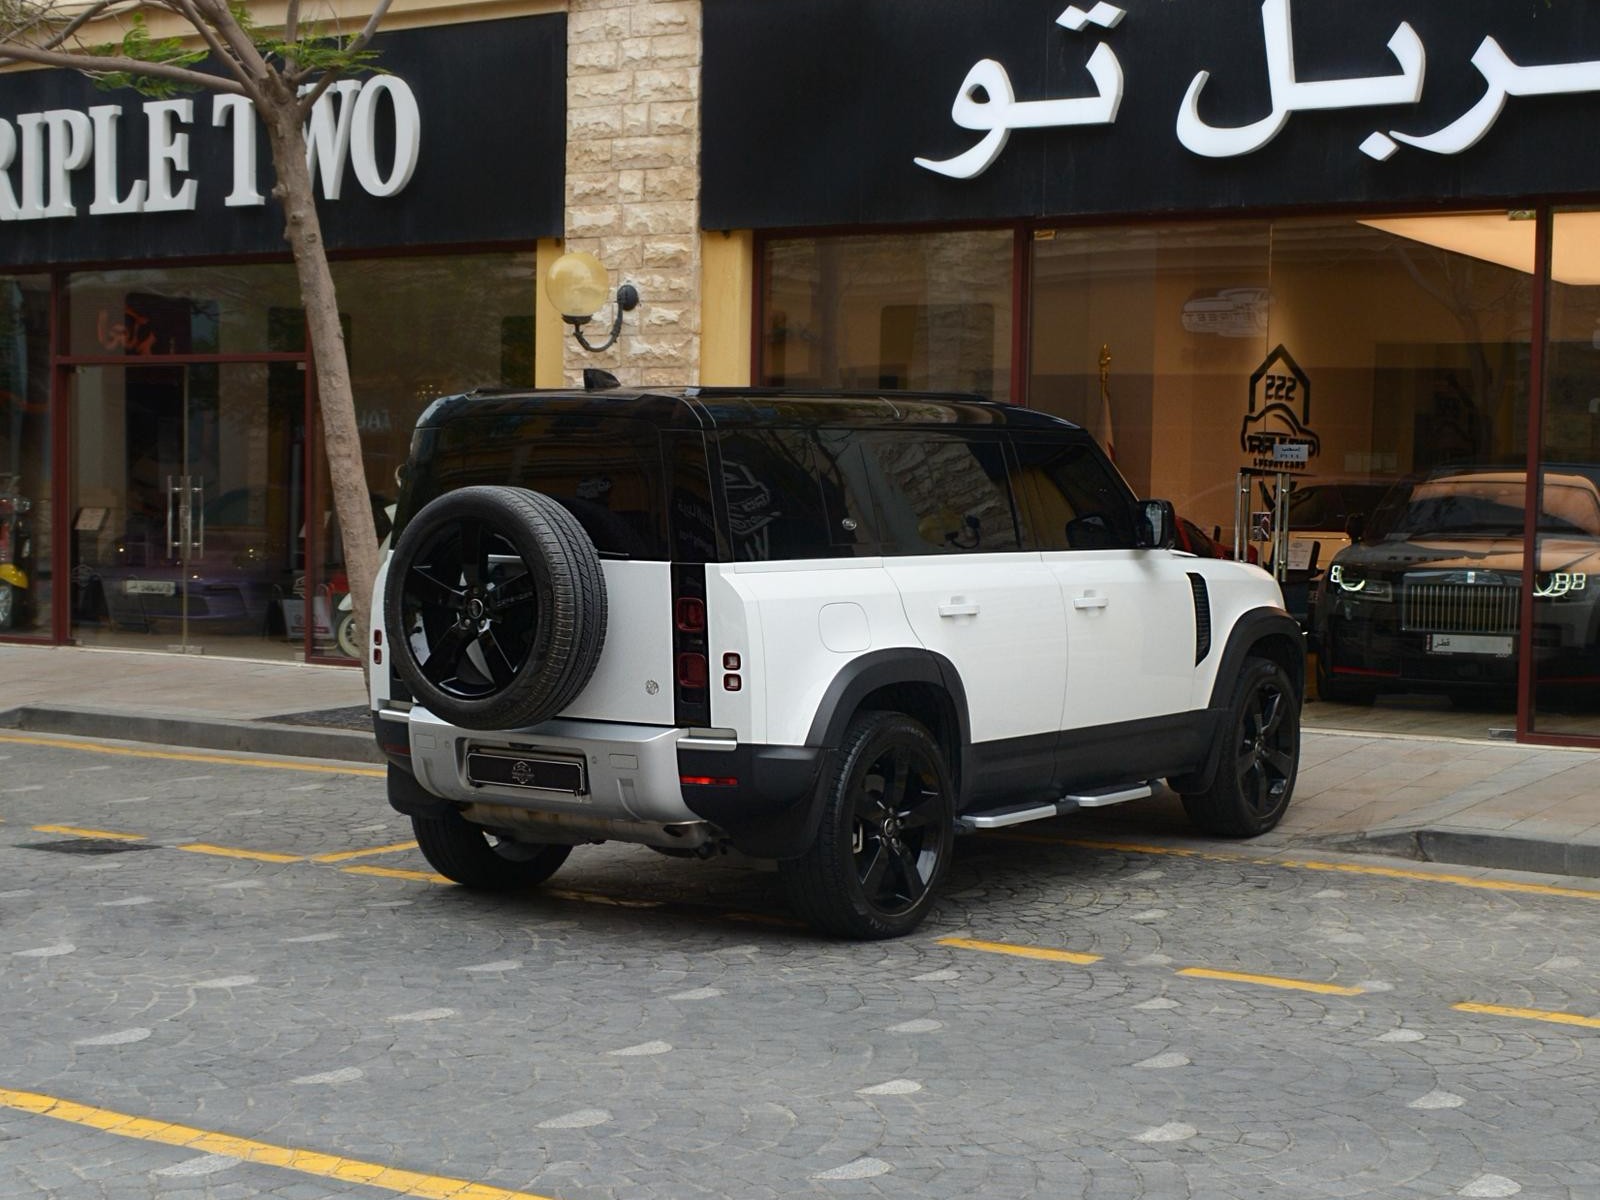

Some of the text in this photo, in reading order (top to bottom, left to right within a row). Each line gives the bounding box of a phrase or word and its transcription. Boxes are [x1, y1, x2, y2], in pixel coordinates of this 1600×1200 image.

[212, 73, 421, 207] TWO
[914, 0, 1600, 179] ربل تو
[1265, 375, 1297, 402] 222
